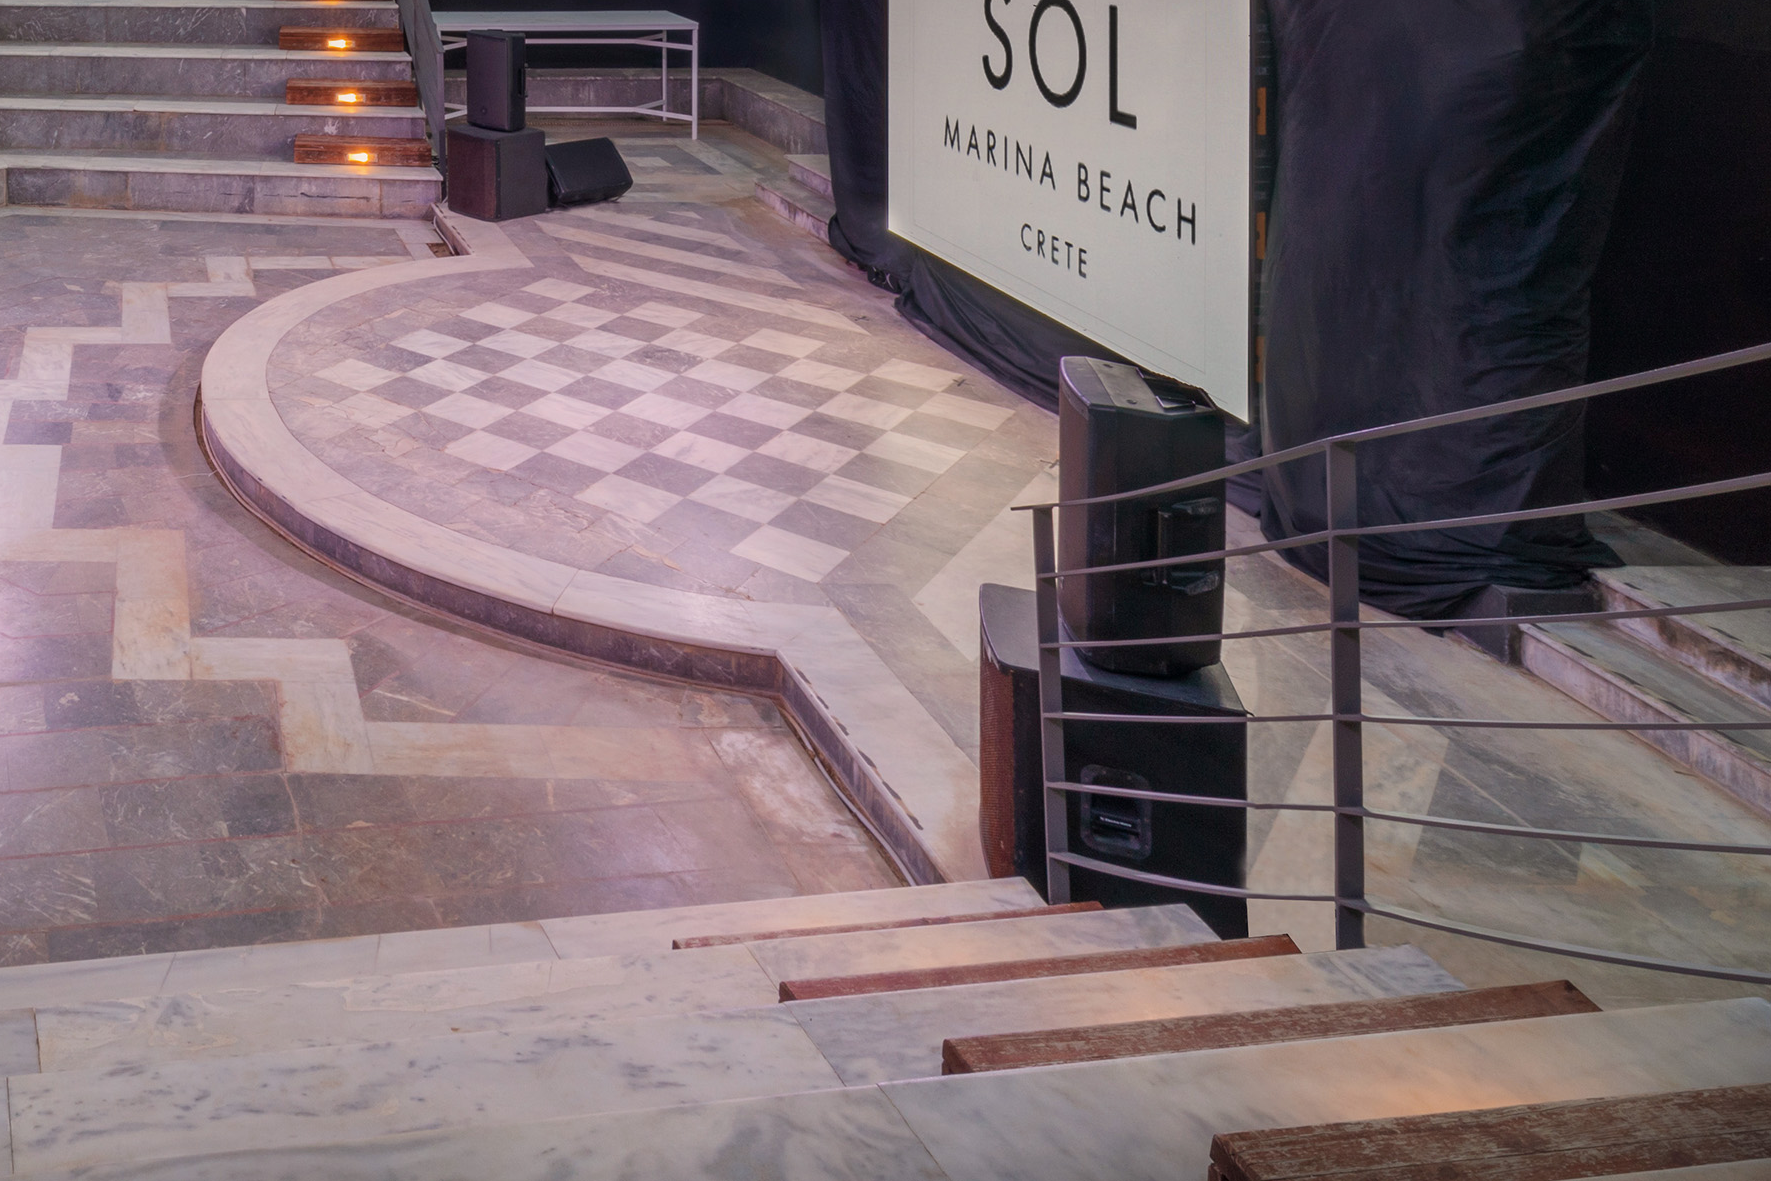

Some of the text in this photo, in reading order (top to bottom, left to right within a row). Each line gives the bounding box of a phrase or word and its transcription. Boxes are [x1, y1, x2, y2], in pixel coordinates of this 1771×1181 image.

[944, 116, 1196, 246] MARINA BEACH
[1020, 223, 1087, 279] CRETE
